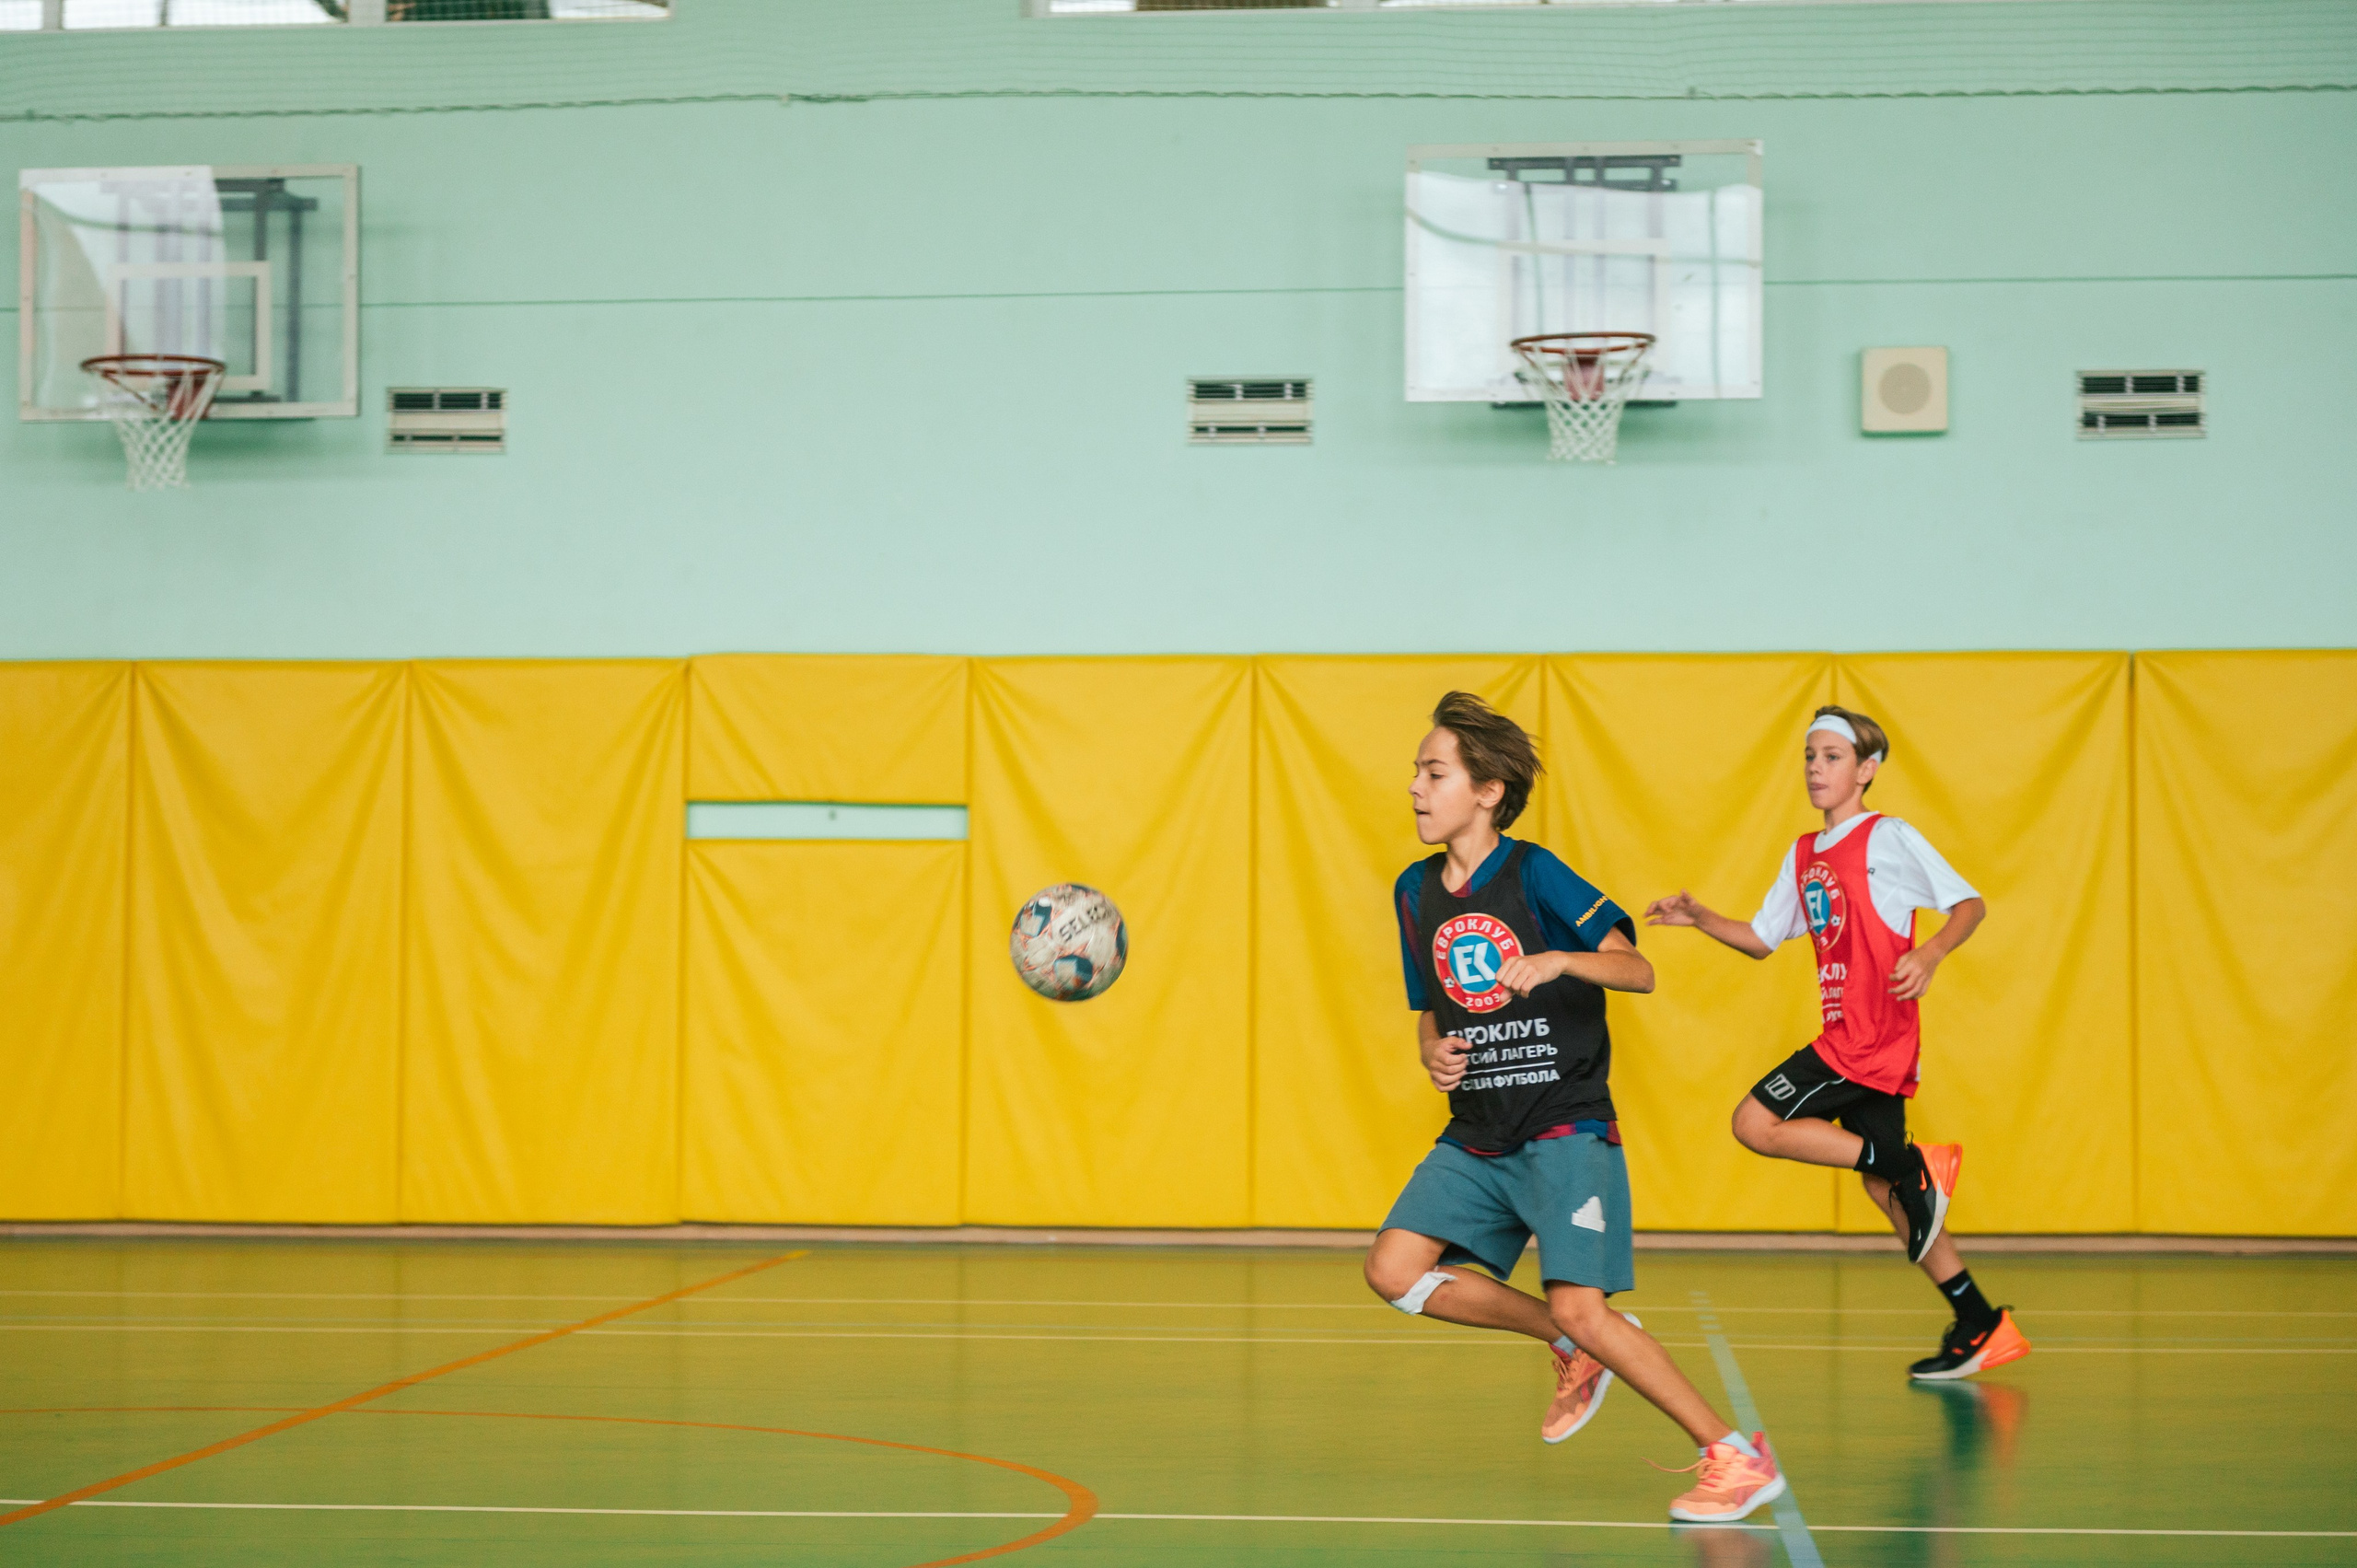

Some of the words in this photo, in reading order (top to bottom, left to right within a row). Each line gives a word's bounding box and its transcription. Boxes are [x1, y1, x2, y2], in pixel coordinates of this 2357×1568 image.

[1575, 895, 1609, 927] AMBILIGH
[1435, 918, 1515, 960] ЕВРОКЛУБ
[1465, 993, 1501, 1007] 2003
[1501, 1043, 1559, 1062] ЛАГЕРЬ
[1492, 1069, 1562, 1088] ФУТБОЛА
